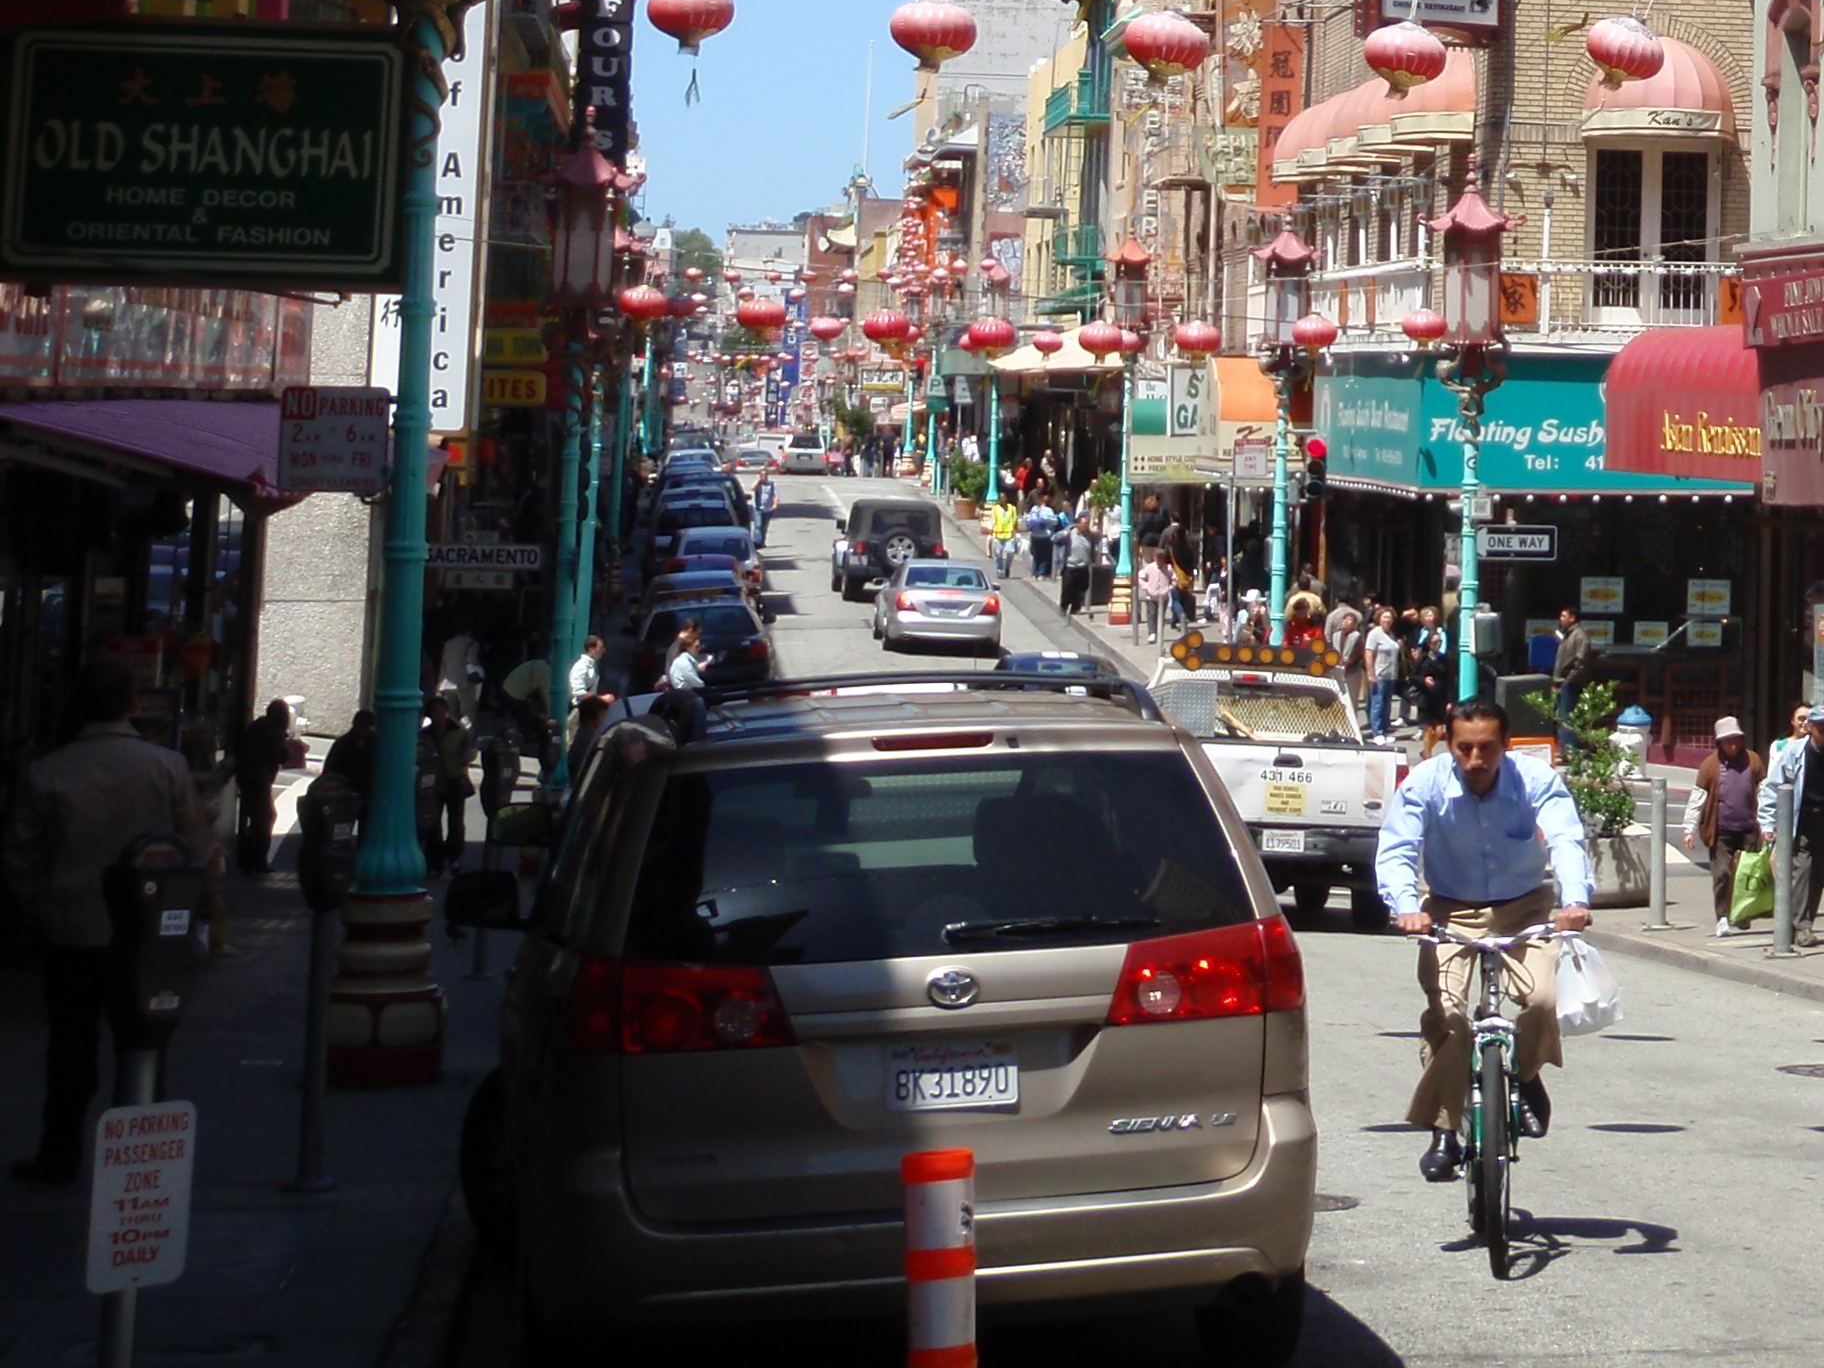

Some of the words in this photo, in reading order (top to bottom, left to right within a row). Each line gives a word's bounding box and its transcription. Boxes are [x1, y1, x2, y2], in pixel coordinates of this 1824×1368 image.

[33, 117, 126, 173] OLD
[138, 121, 374, 180] SHANGHAI
[1141, 110, 1162, 254] BAKERY
[104, 187, 186, 207] HOME
[202, 188, 297, 209] DECOR
[190, 206, 209, 225] &
[66, 221, 200, 243] ORIENTAL
[216, 226, 333, 246] FASHION
[431, 151, 464, 409] America
[484, 378, 536, 400] ITES
[285, 390, 316, 417] NO
[319, 397, 385, 417] PARKING
[1537, 418, 1607, 447] Sush
[1697, 411, 1763, 456] Renaissan
[1524, 454, 1560, 470] Tel:
[1487, 536, 1514, 549] ONE
[1518, 536, 1546, 549] WAY
[427, 547, 539, 565] SACRAMENTO
[1260, 770, 1284, 782] 431
[1288, 771, 1313, 783] 466
[896, 1063, 1008, 1104] 8K31890
[104, 1119, 125, 1140] NO
[129, 1112, 190, 1138] PARKING
[1107, 1113, 1204, 1135] SIENNA
[104, 1139, 186, 1167] PASSENGER
[124, 1169, 162, 1193] ZONE
[113, 1196, 171, 1213] 11AM
[119, 1212, 163, 1226] THRU
[110, 1227, 171, 1245] 10PM
[112, 1245, 161, 1267] DAILY
